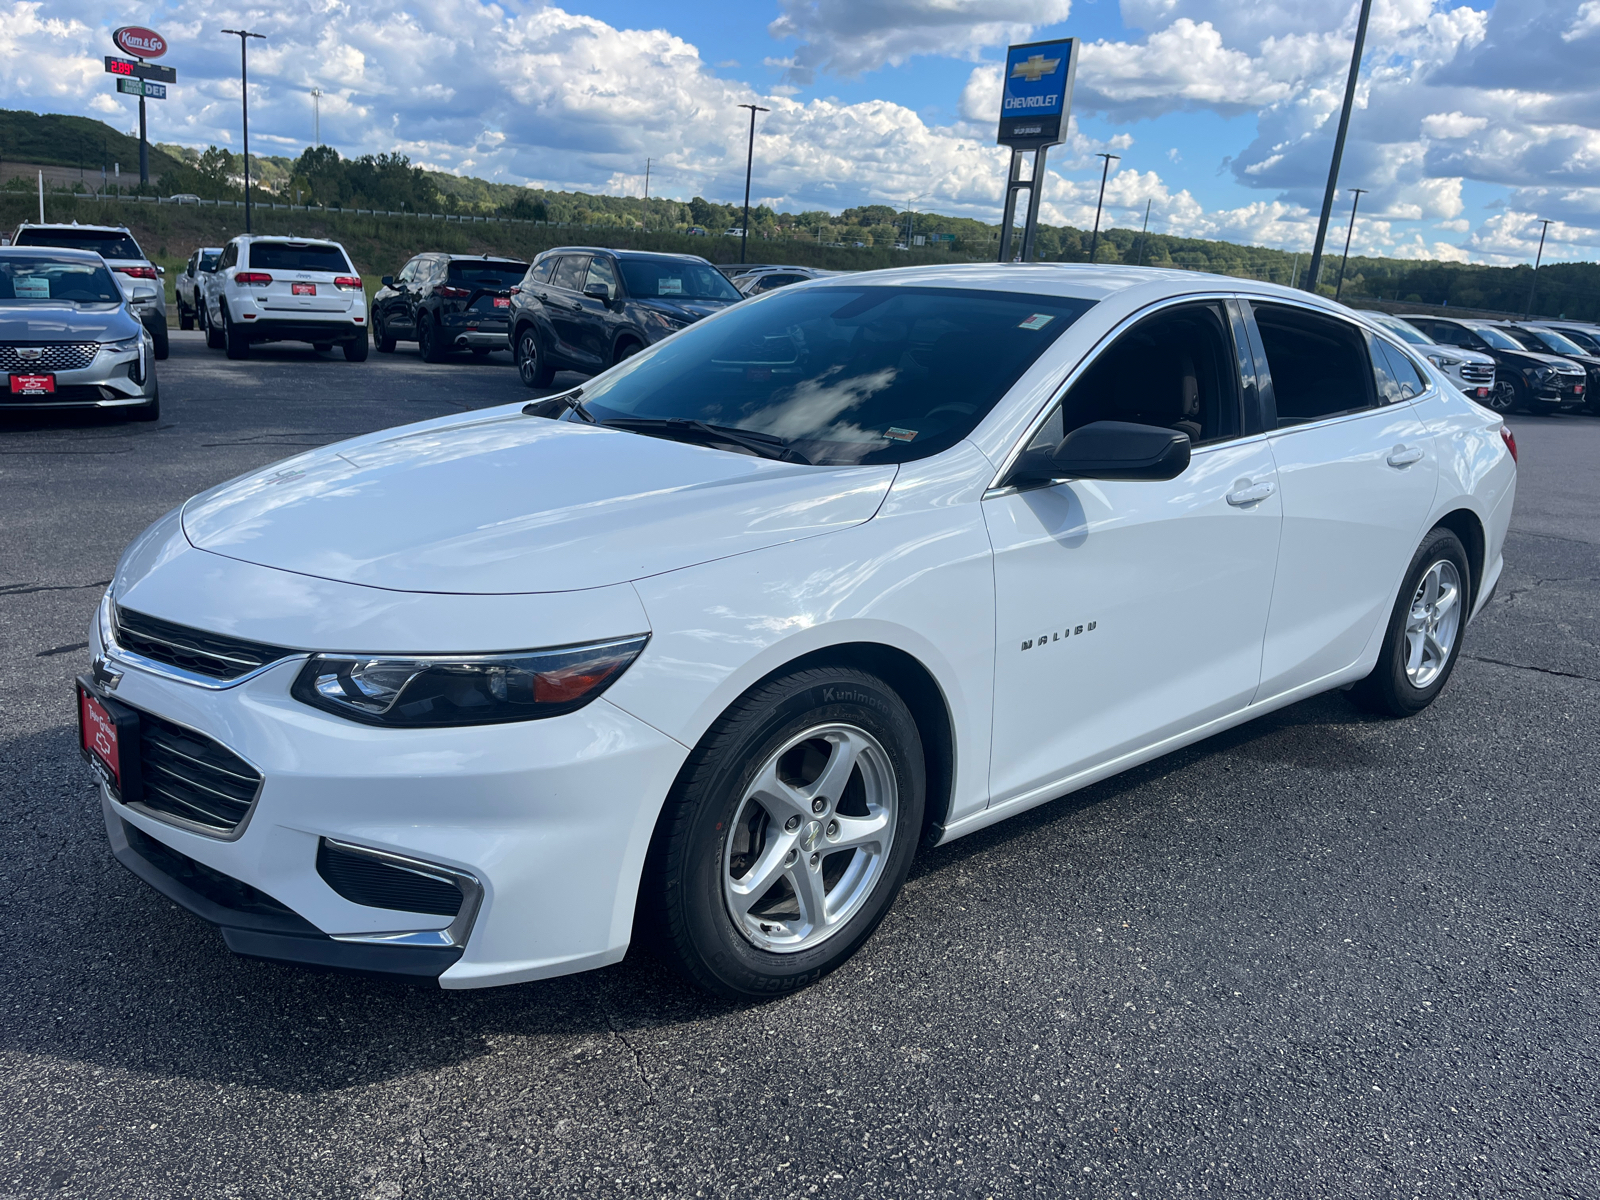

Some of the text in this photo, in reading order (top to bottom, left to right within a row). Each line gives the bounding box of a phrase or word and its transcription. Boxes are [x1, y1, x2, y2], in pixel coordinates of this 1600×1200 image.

[122, 32, 162, 51] Kum & Go
[145, 84, 165, 96] DEF
[1005, 95, 1058, 109] CHEVROLET
[1020, 620, 1097, 651] MALIBU
[822, 687, 889, 713] Kunimoto
